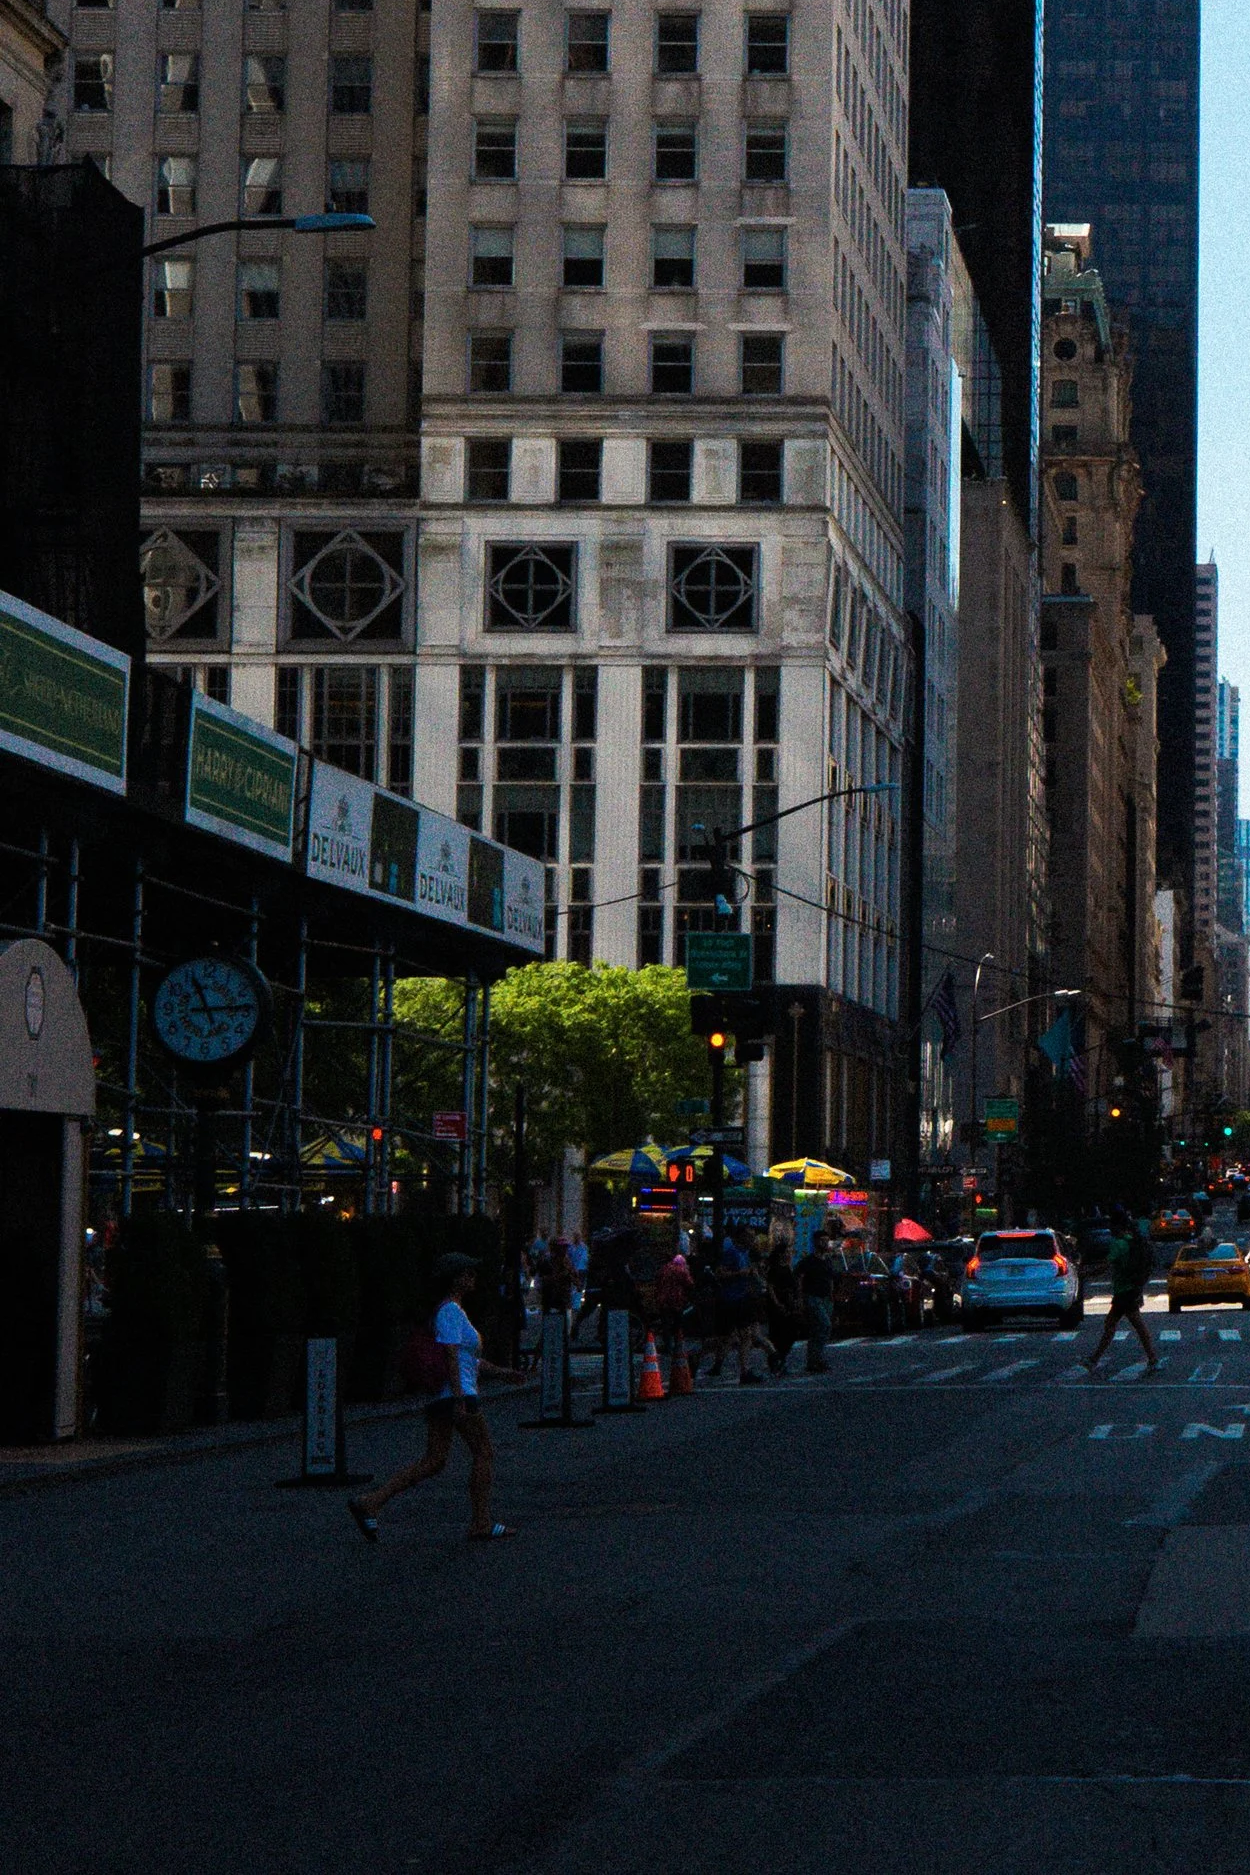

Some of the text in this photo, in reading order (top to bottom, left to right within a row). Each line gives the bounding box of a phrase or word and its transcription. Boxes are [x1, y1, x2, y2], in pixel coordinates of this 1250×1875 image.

[311, 831, 366, 877] DELVAUX
[419, 872, 465, 912] DELVAUX
[507, 905, 544, 940] DELVAUX
[203, 963, 217, 978] 12
[170, 982, 182, 997] 10
[238, 983, 249, 998] 2
[163, 1002, 174, 1016] 9
[234, 1023, 244, 1034] 4
[183, 1035, 191, 1047] 7
[200, 1041, 210, 1055] 6
[221, 1037, 231, 1051] 5
